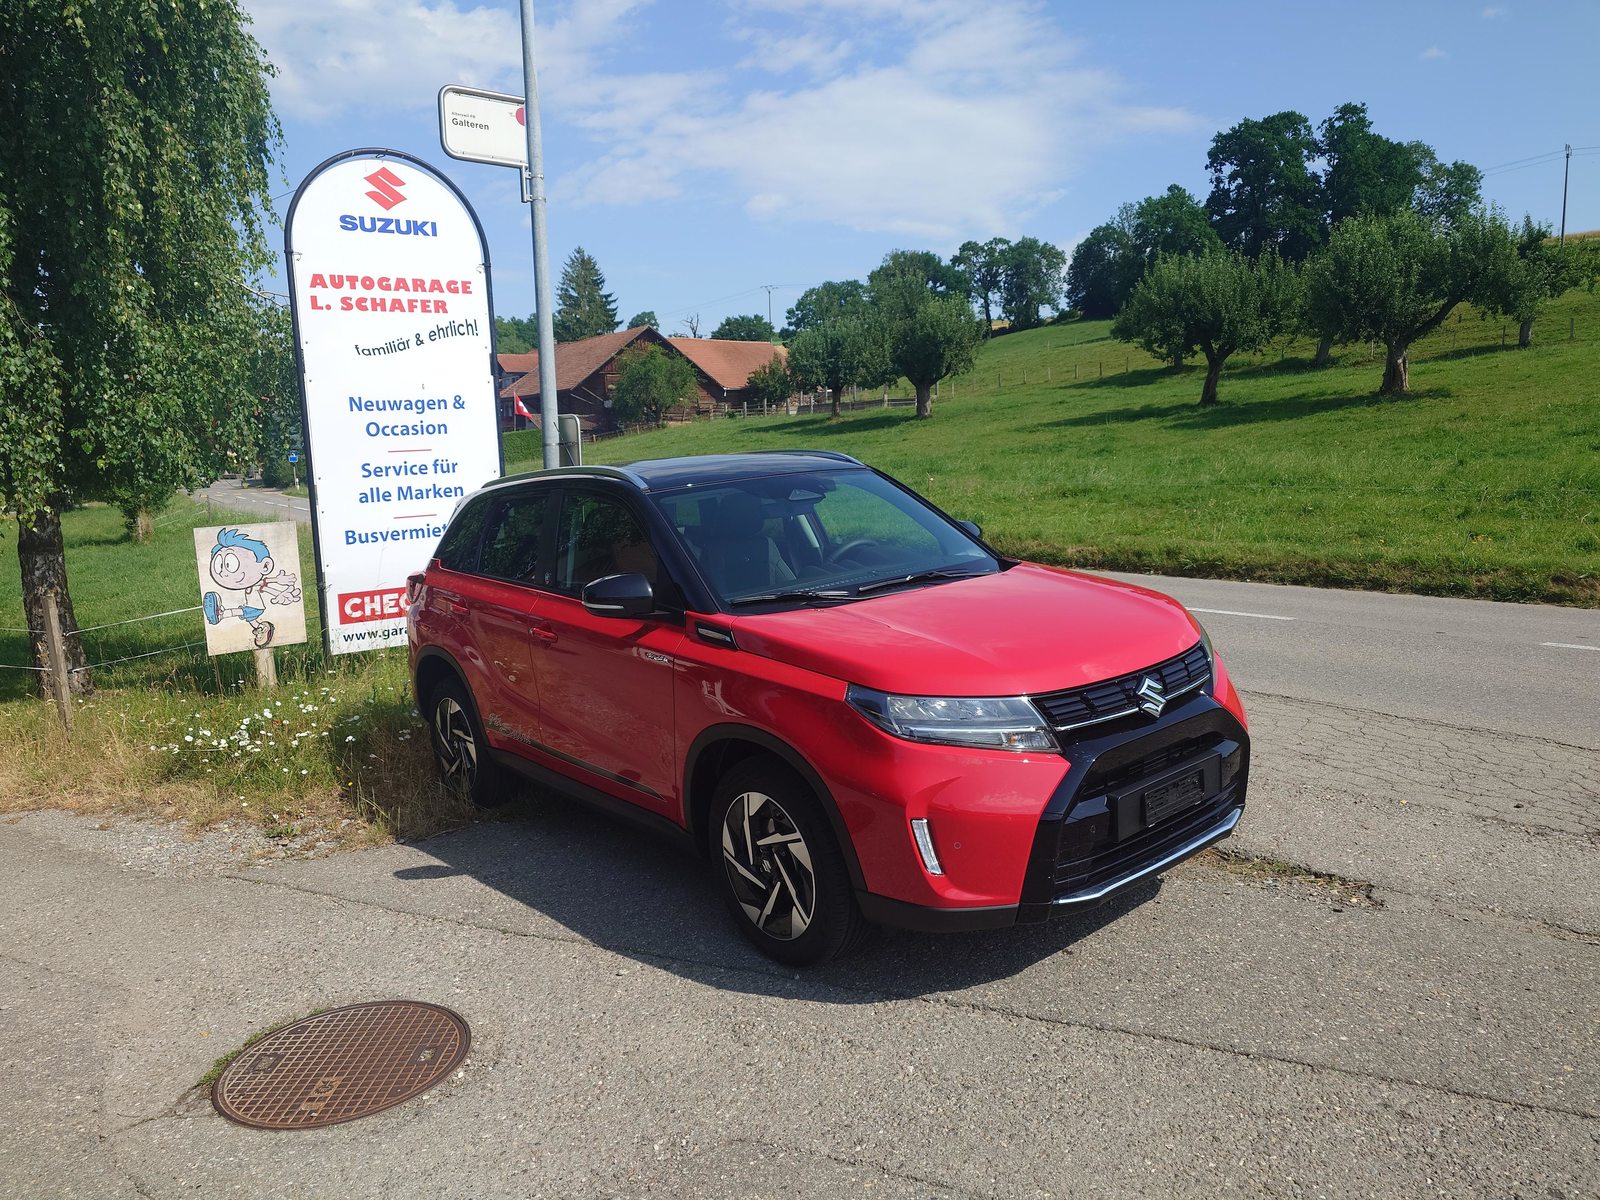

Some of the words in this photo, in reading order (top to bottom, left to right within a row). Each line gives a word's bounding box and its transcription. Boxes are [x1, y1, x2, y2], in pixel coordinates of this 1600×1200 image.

[451, 117, 490, 131] Galteren
[339, 214, 438, 237] SUZUKI
[309, 273, 473, 295] AUTOGARAGE
[310, 295, 332, 311] L.
[340, 296, 449, 314] SCHAFER
[354, 338, 411, 357] familiär
[415, 332, 425, 347] &
[428, 318, 479, 342] ehrlich!
[348, 396, 448, 414] Neuwagen
[453, 395, 466, 410] &
[365, 420, 448, 437] Occasion
[361, 460, 428, 478] Service
[432, 459, 459, 474] für
[358, 487, 392, 504] alle
[397, 483, 464, 501] Marken
